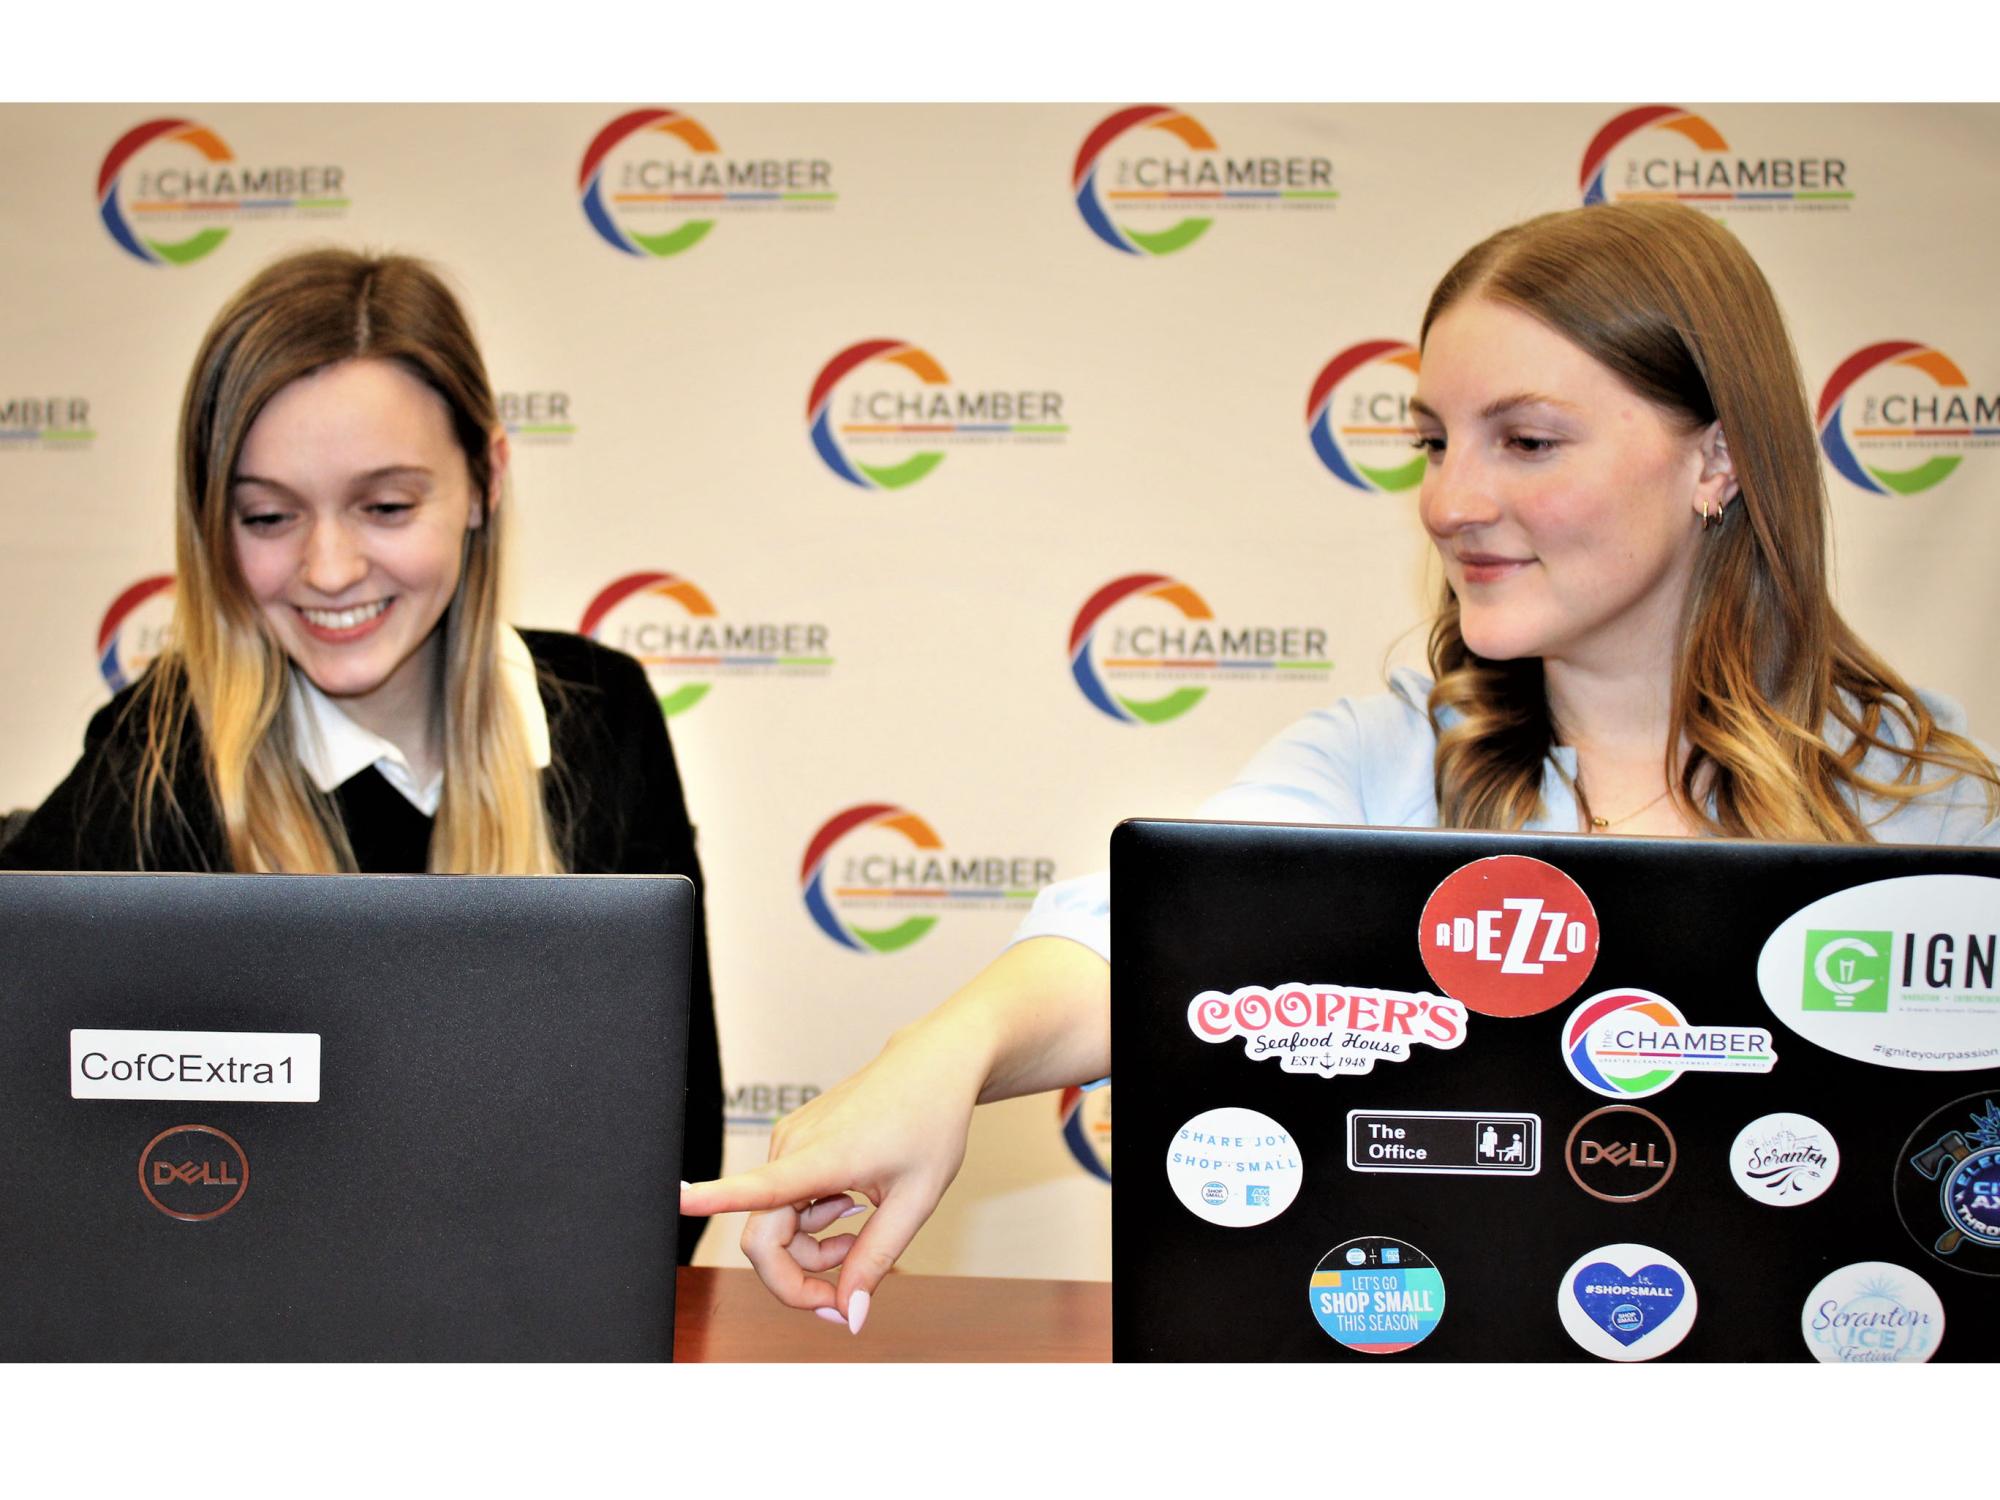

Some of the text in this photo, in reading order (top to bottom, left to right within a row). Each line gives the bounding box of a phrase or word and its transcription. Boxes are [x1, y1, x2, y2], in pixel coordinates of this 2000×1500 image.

[156, 166, 344, 199] CHAMBER
[635, 158, 832, 190] CHAMBER
[1133, 157, 1332, 187] CHAMBER
[1643, 158, 1847, 188] CHAMBER
[869, 390, 1063, 421] CHAMBER
[635, 622, 828, 653] CHAMBER
[1129, 626, 1327, 657] CHAMBER
[860, 855, 1055, 886] CHAMBER
[1436, 898, 1586, 974] ADEZZO
[1902, 933, 1997, 989] IGN
[1197, 991, 1459, 1041] COOPER'S
[1254, 1031, 1401, 1055] Seafood House
[1616, 1030, 1764, 1053] CHAMBER
[80, 1052, 293, 1084] CofCExtra1
[1290, 1055, 1366, 1068] EST 1948
[1180, 1129, 1287, 1147] SHARE JOY
[1368, 1124, 1405, 1139] The
[1173, 1152, 1297, 1172] SHOP SMALL
[1368, 1144, 1427, 1160] Office
[1580, 1140, 1664, 1167] DELL
[1748, 1146, 1827, 1169] Scranton
[153, 1160, 237, 1185] DELL
[1352, 1276, 1397, 1291] LET'S GO
[1585, 1285, 1673, 1297] #SHOPSMALL
[1320, 1290, 1433, 1314] SHOP SMALL
[1812, 1300, 1929, 1330] Scranton
[1337, 1314, 1418, 1331] THIS SEASON
[1847, 1327, 1896, 1349] ICE
